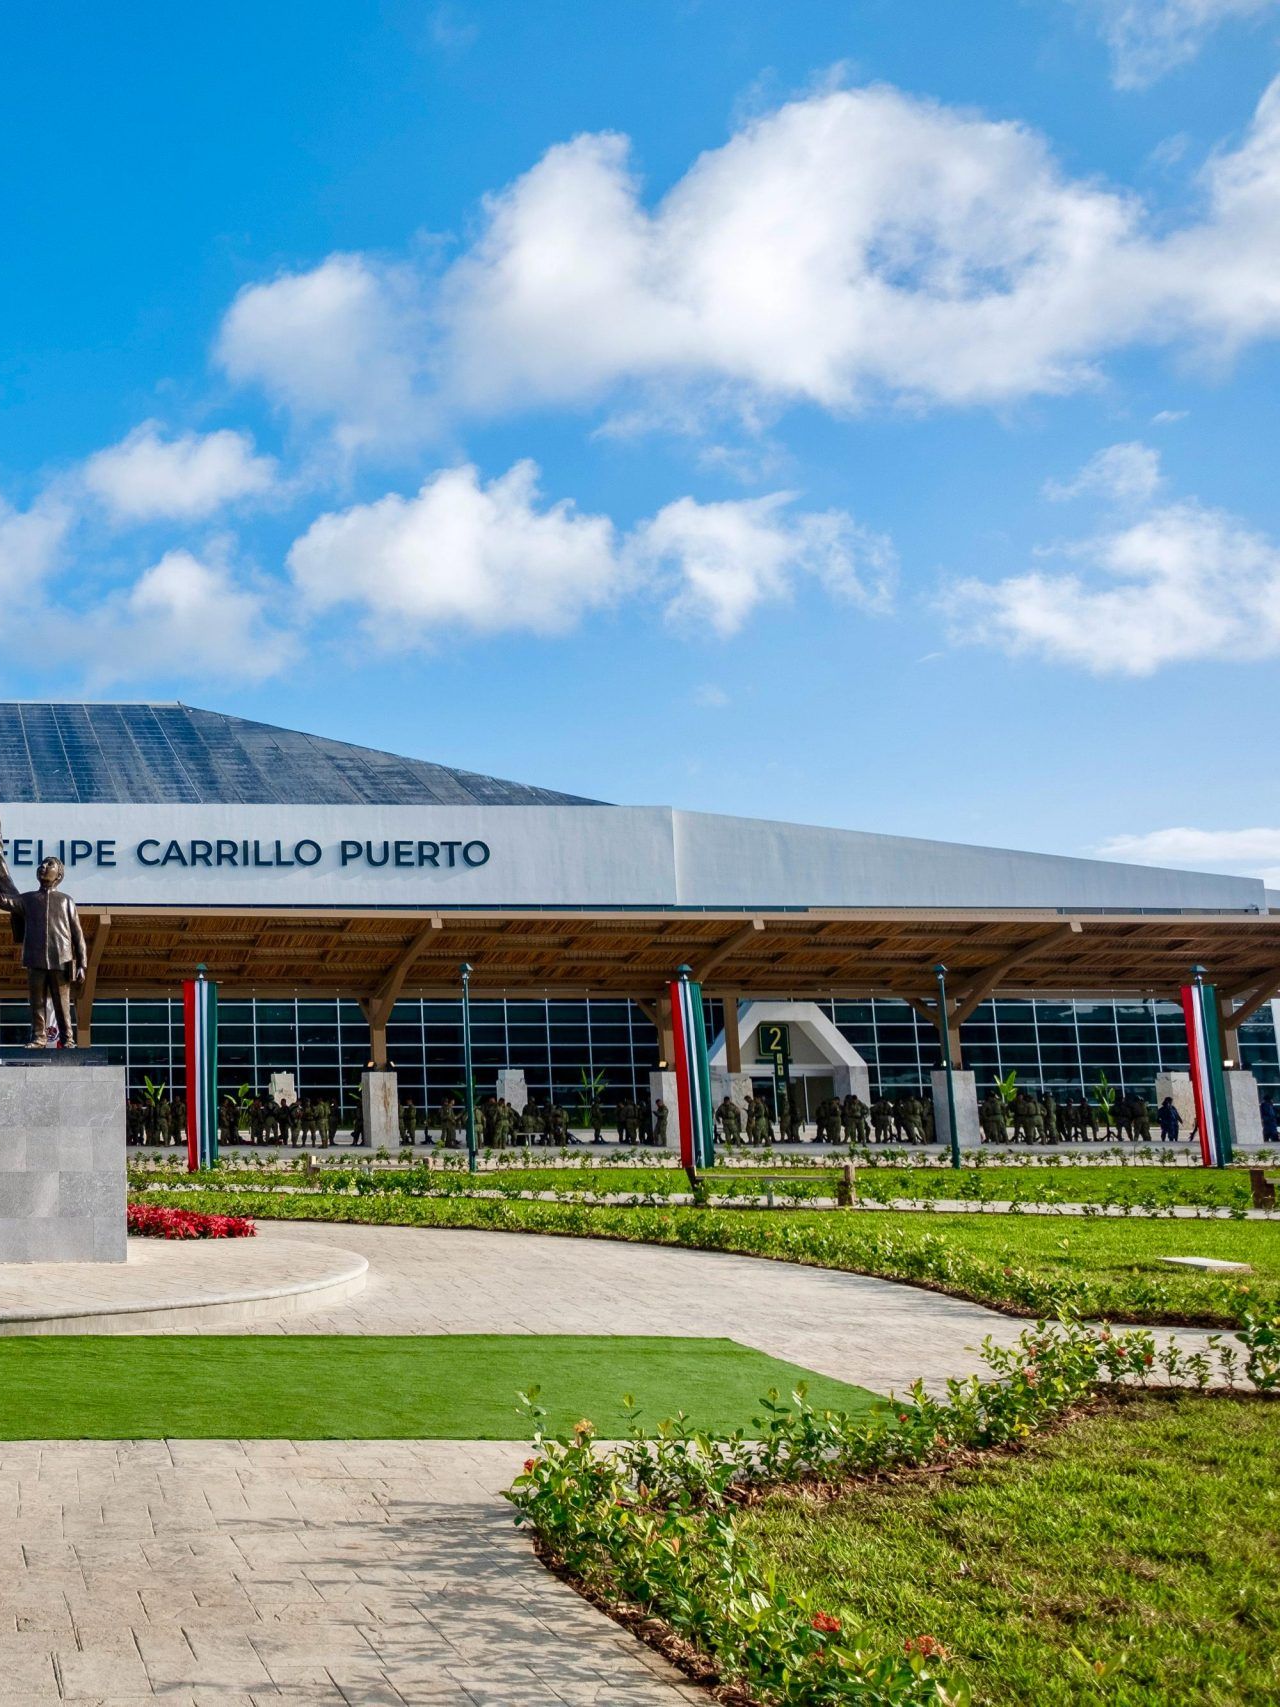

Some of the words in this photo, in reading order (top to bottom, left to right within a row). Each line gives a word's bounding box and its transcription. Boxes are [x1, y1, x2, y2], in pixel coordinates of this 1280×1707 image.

[136, 839, 322, 867] CARRILLO
[340, 840, 491, 868] PUERTO
[769, 1027, 782, 1050] 2
